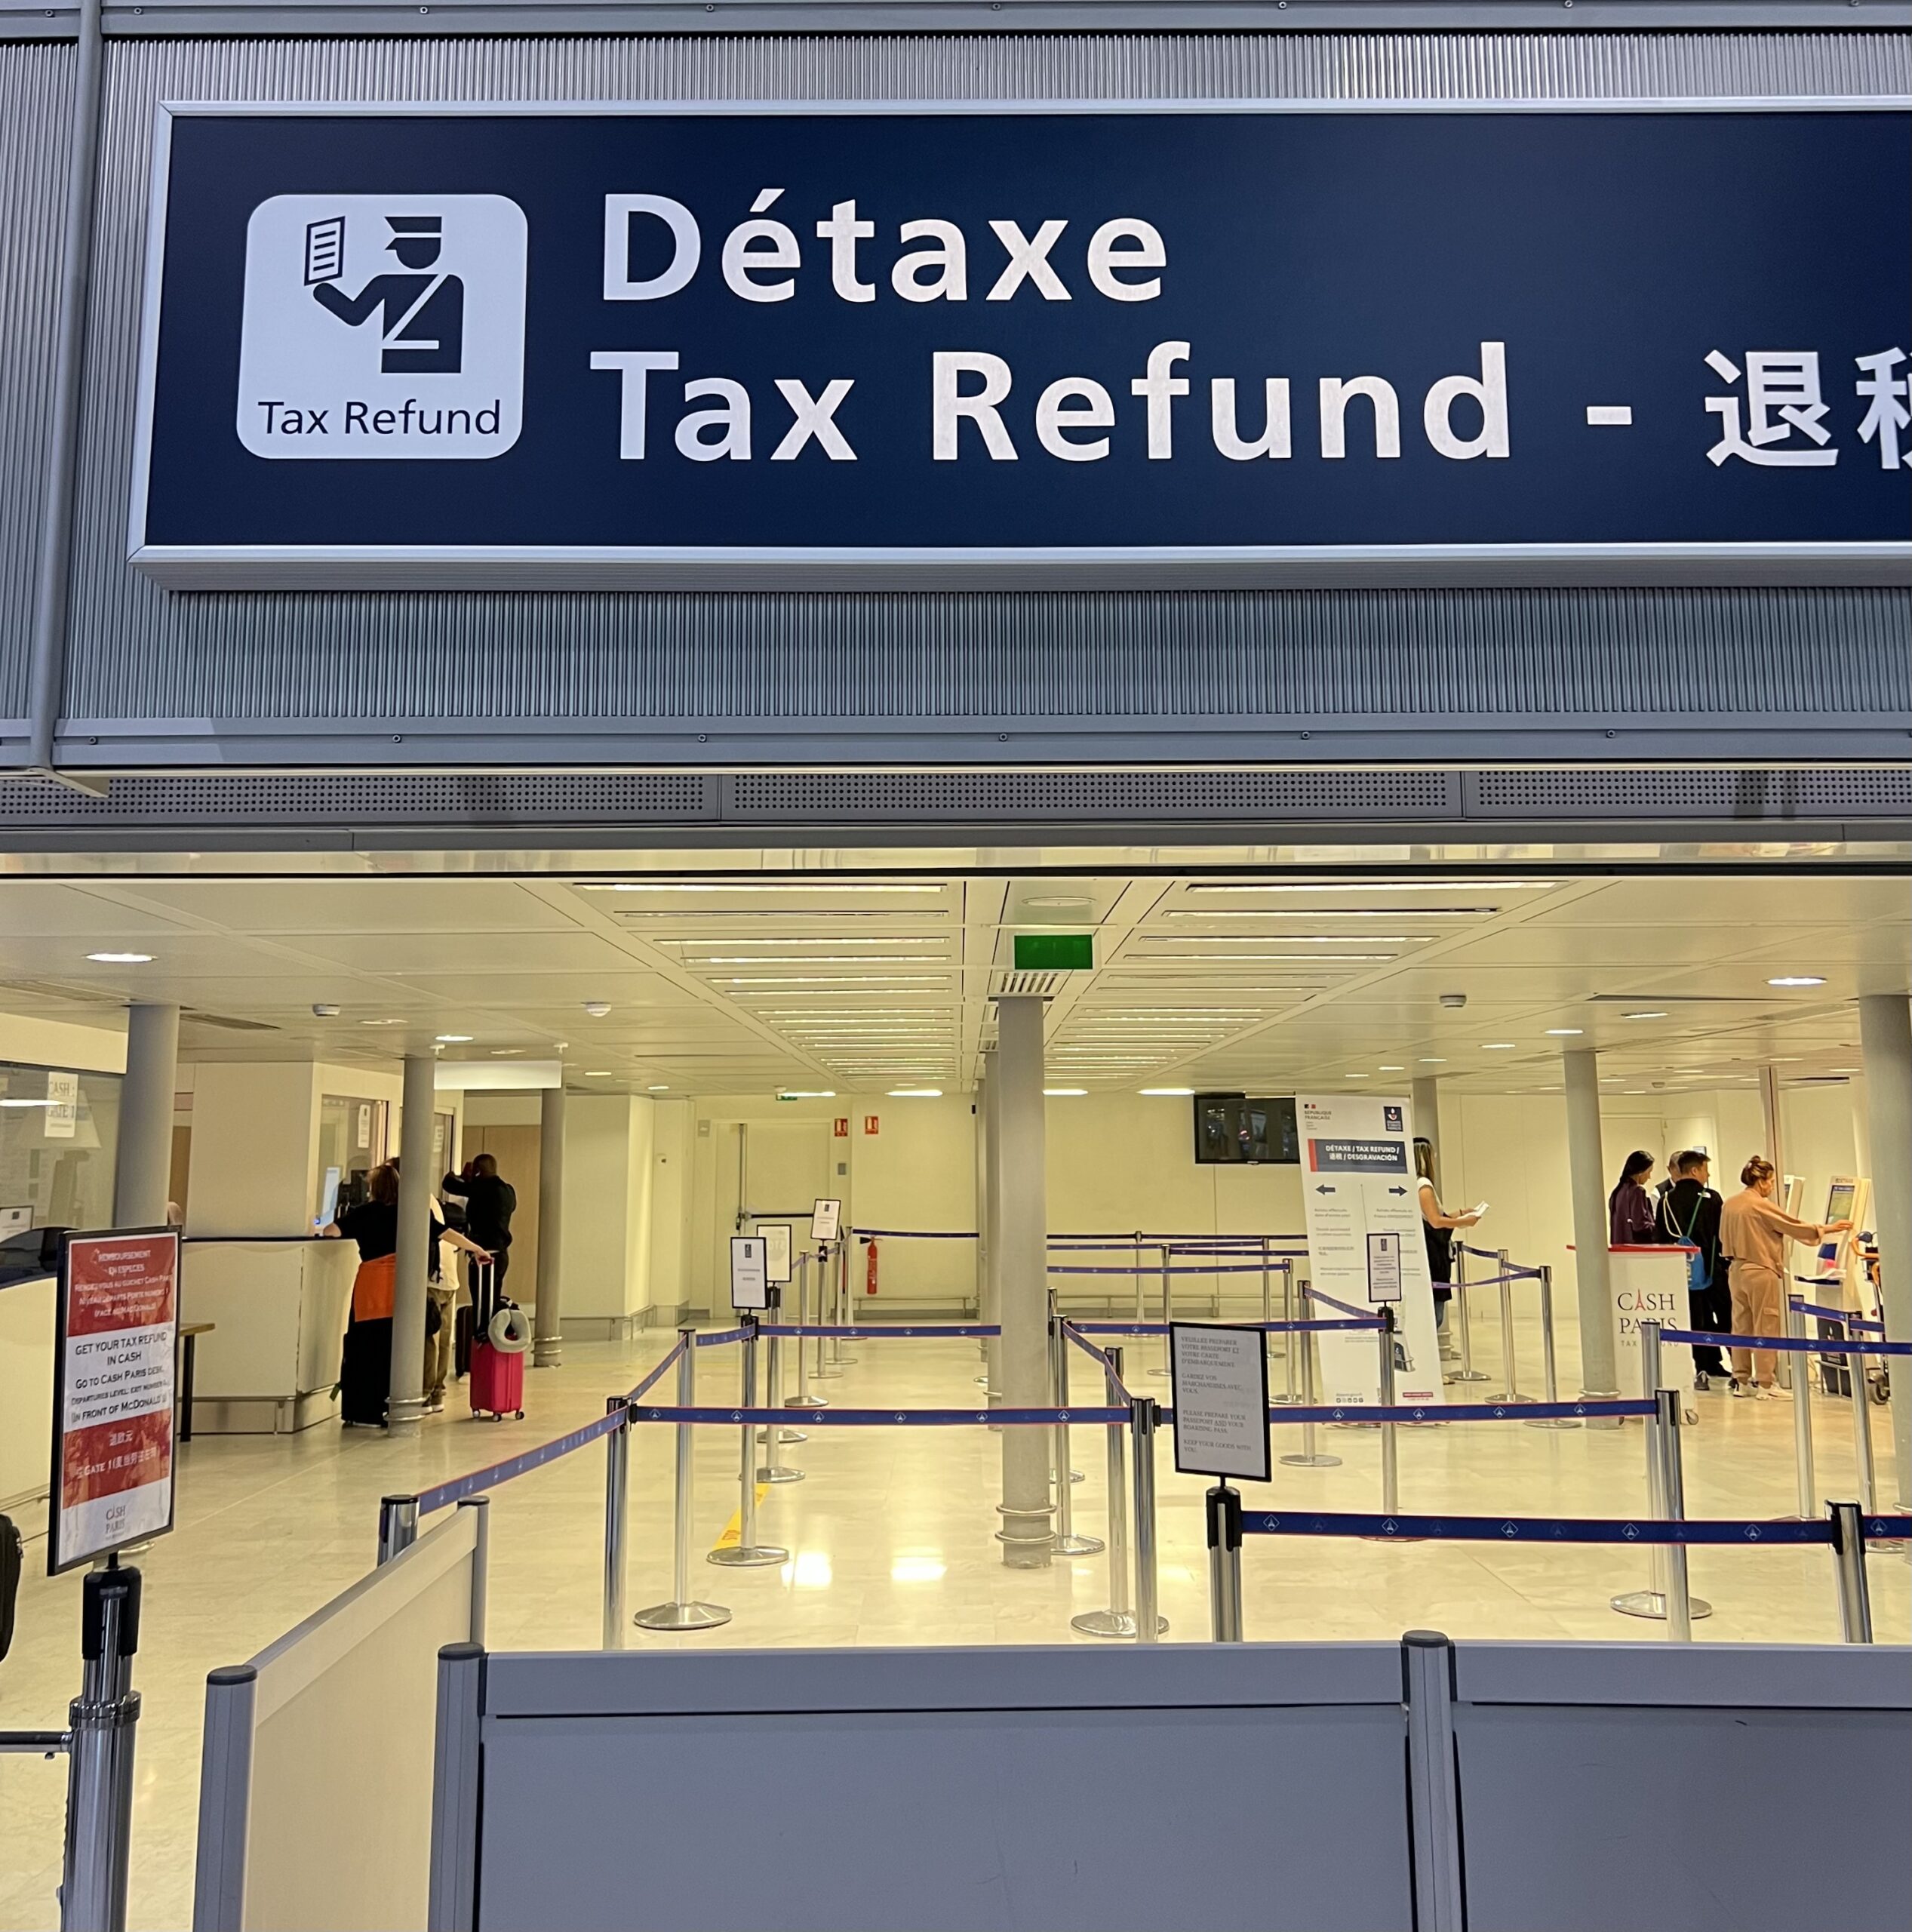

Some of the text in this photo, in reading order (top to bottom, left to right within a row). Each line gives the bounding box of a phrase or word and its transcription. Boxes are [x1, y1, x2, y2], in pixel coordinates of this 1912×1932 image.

[603, 188, 1167, 303] Détaxe
[589, 351, 858, 462] Tax
[933, 340, 1510, 462] Refund
[257, 398, 500, 435] Tax Refund
[1618, 1288, 1675, 1311] CASH
[1619, 1317, 1677, 1334] PAIS
[75, 1331, 167, 1355] GET YOUR TAX REFUND
[107, 1351, 142, 1365] IN CASH
[82, 1407, 108, 1420] FRONT
[109, 1404, 119, 1414] OF
